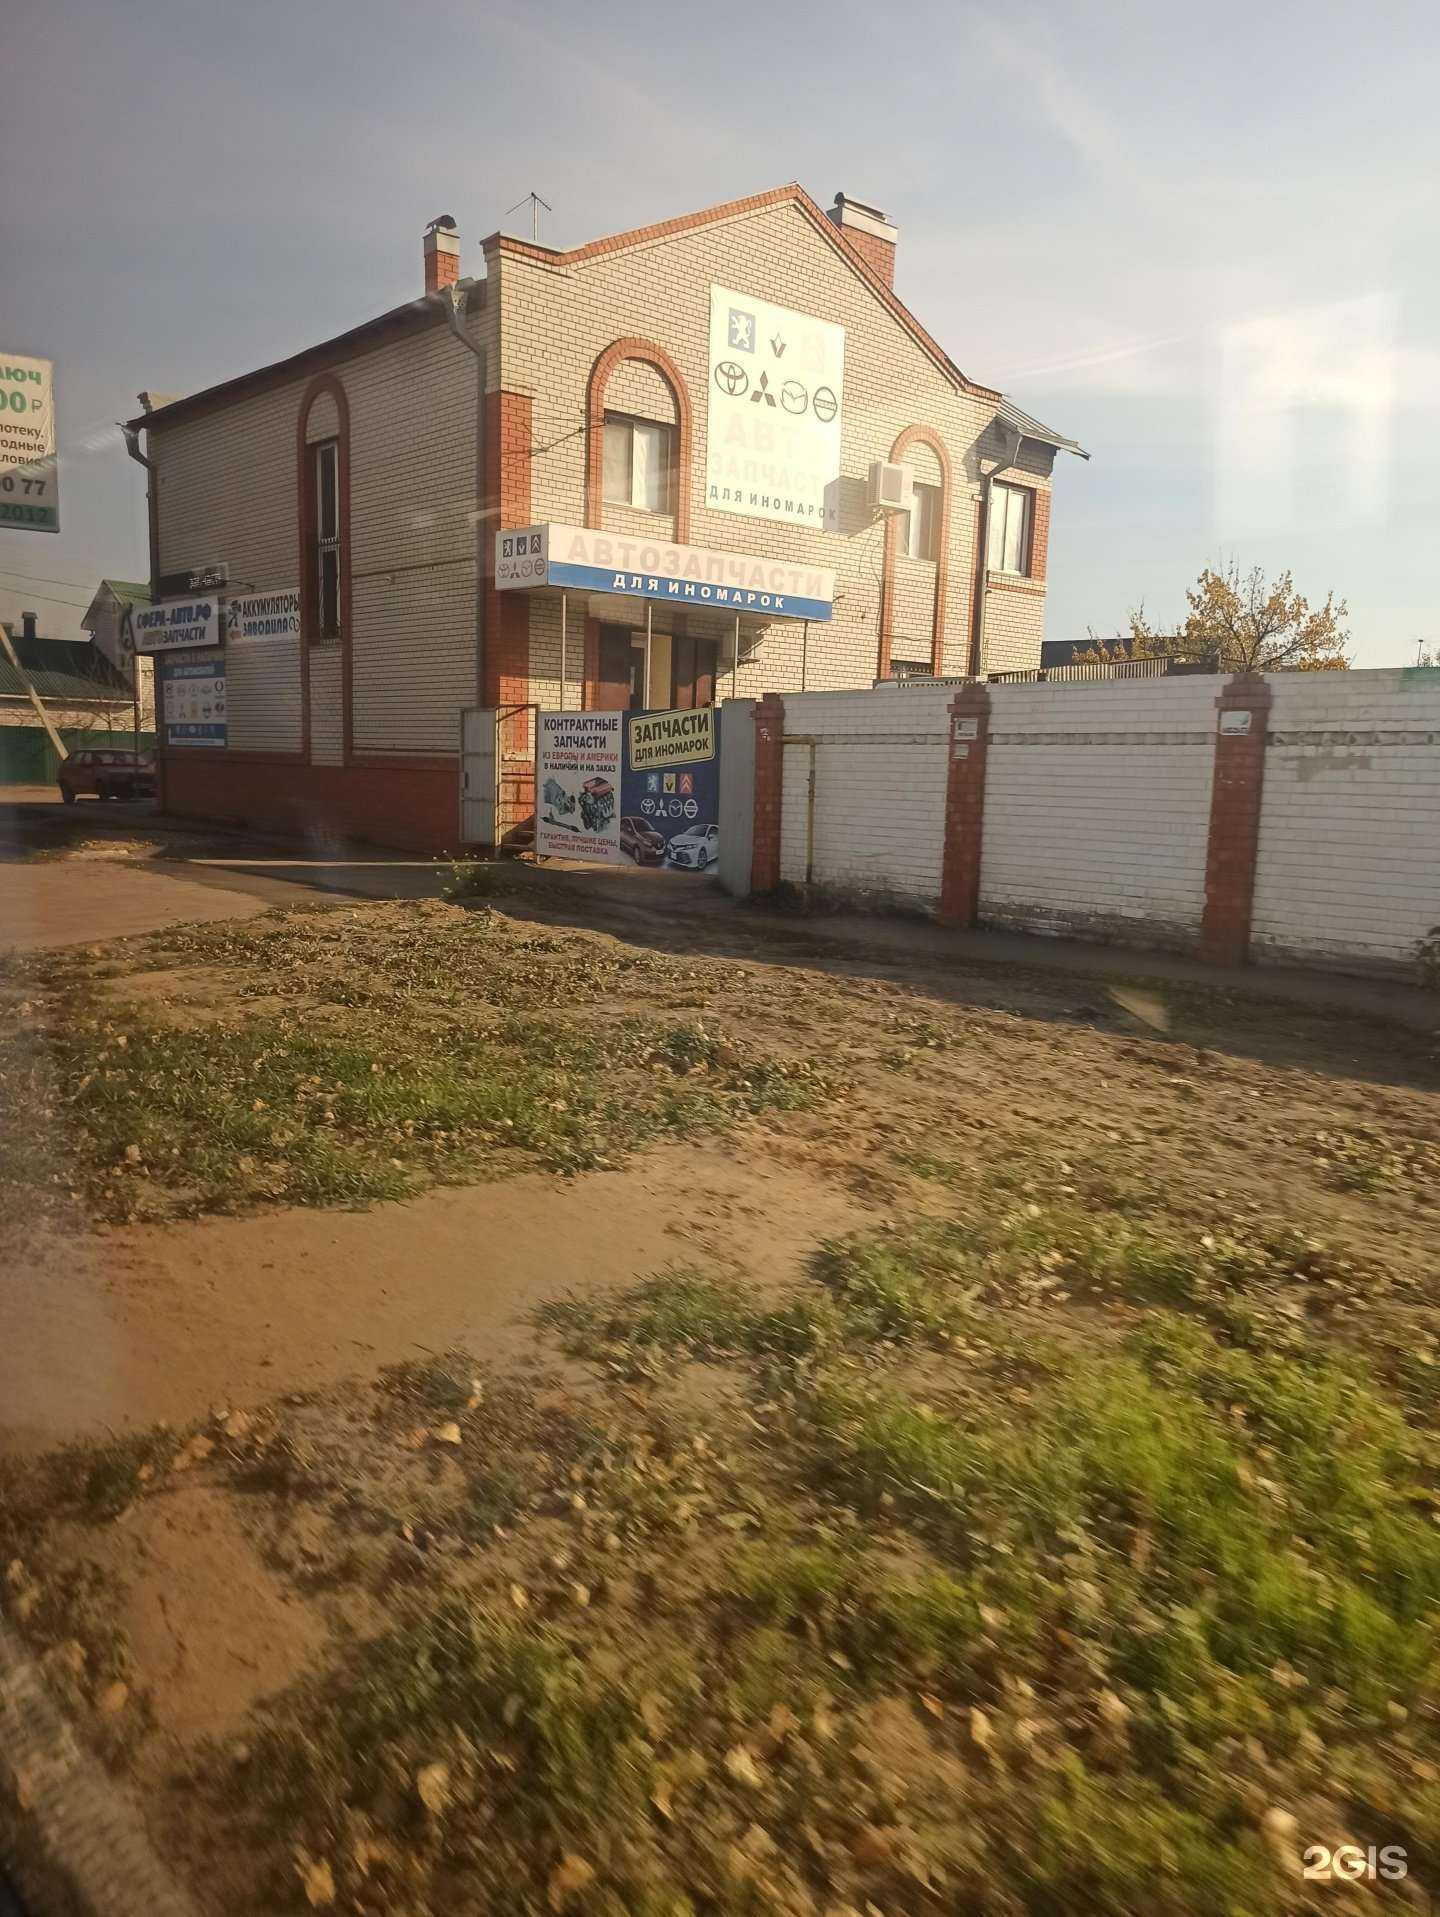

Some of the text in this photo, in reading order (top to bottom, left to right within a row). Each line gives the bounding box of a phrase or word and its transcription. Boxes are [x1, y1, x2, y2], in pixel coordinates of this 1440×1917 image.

[0, 476, 47, 496] 0 77
[709, 485, 837, 522] ДЛЯ ИНОМАРОК
[567, 535, 824, 598] АВТОЗАПЧАСТИ
[613, 574, 785, 609] ДЛЯ ИНОМАРОК
[544, 718, 618, 732] КОНТРАКТНЫЕ
[634, 713, 709, 744] ЗАПЧАСТИ
[554, 735, 606, 749] ЗАПЧАСТИ
[634, 738, 709, 762] ДЛЯ ИНОМАРОК
[596, 764, 616, 773] ЗАКАЗ
